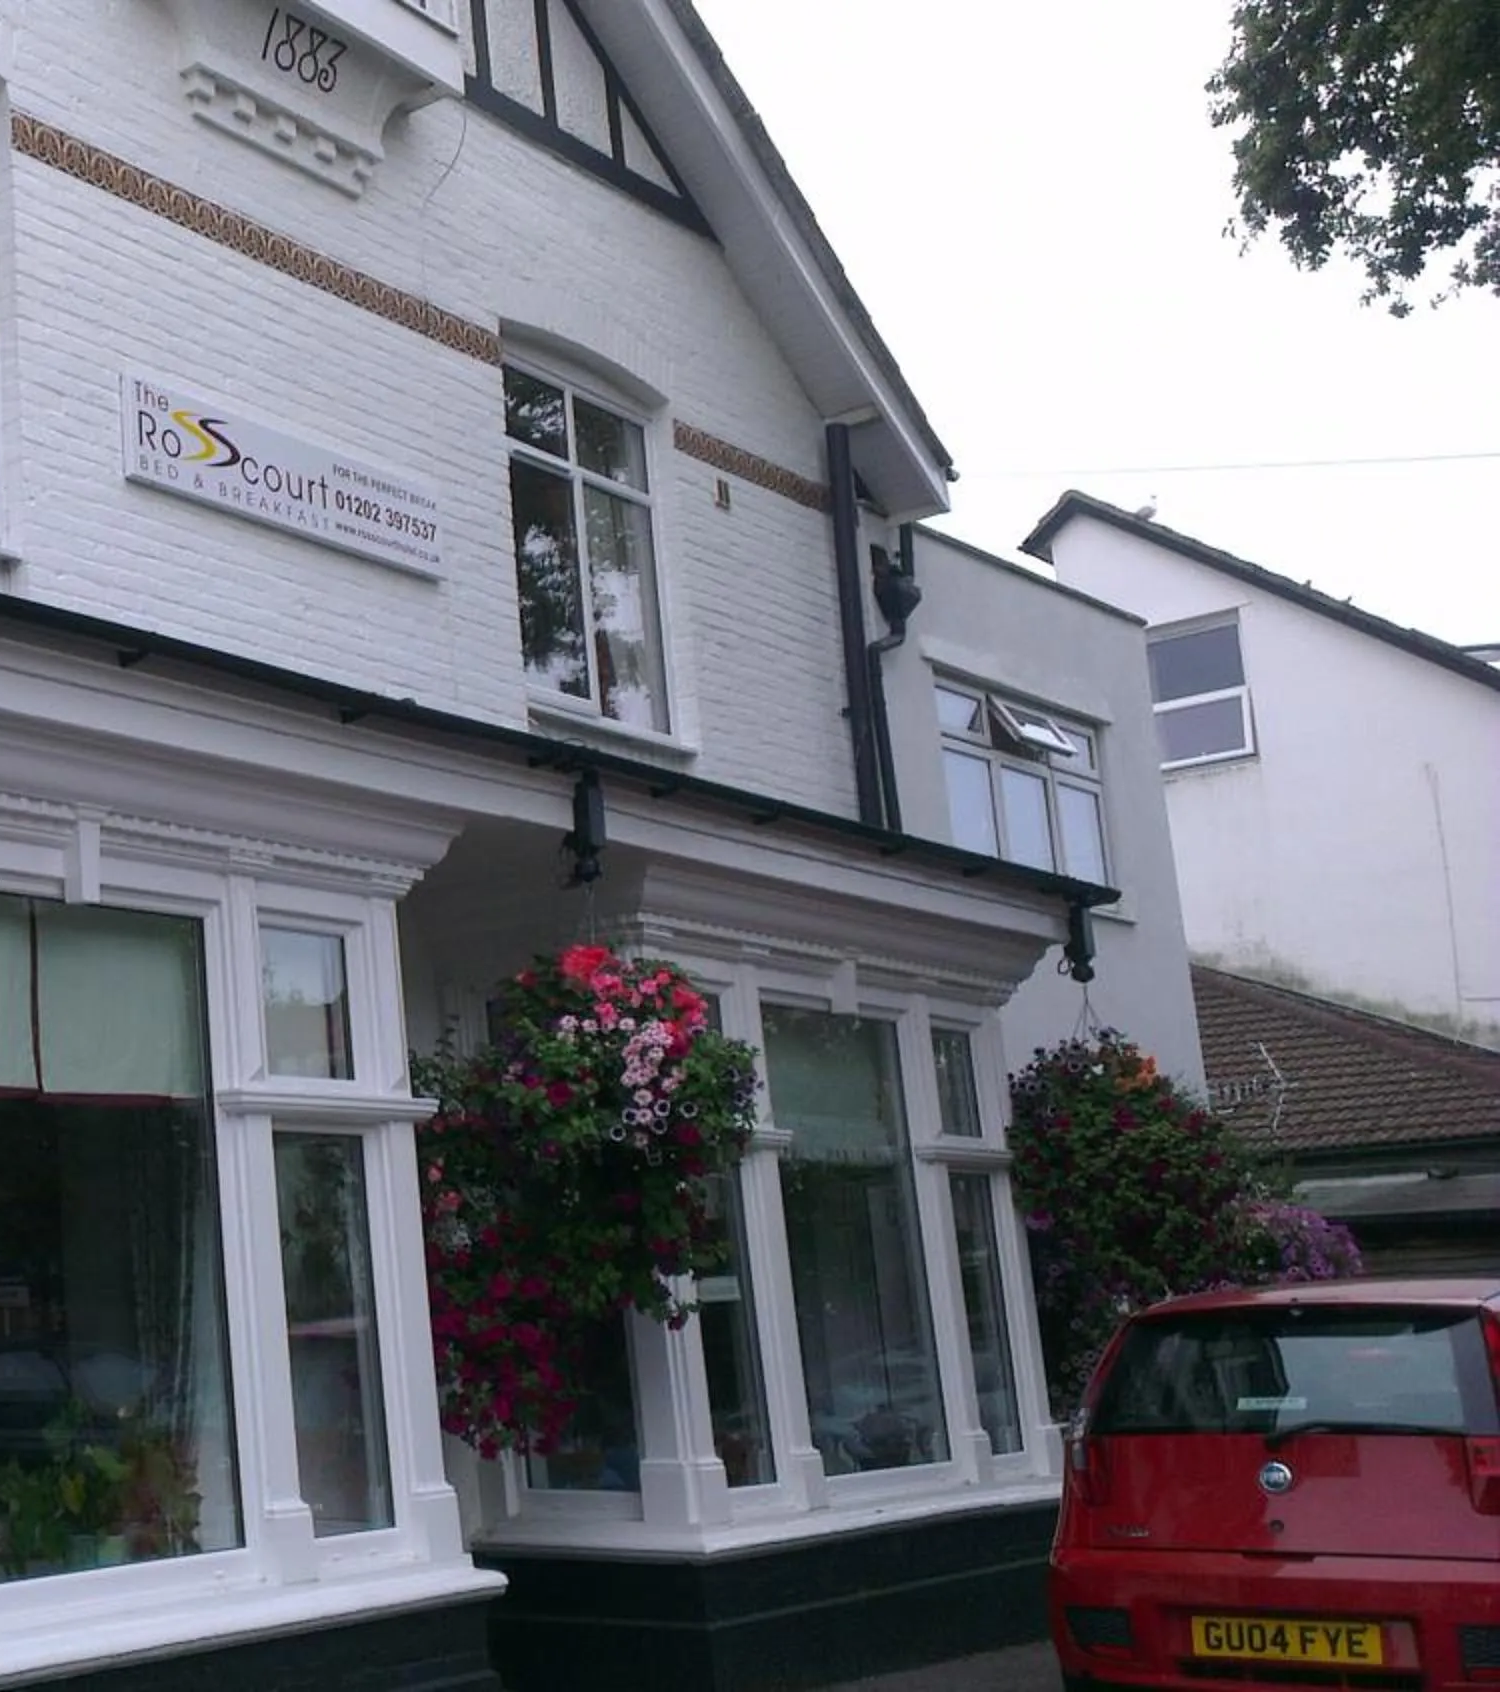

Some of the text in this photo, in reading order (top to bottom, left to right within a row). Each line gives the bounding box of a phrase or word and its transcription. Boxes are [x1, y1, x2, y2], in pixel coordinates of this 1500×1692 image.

[262, 7, 347, 92] 1883
[134, 380, 169, 412] The
[138, 455, 331, 532] BED & BREAKFAST
[353, 471, 368, 486] THE
[335, 490, 437, 543] 01202 397537
[1204, 1620, 1369, 1659] GU04 FYE
